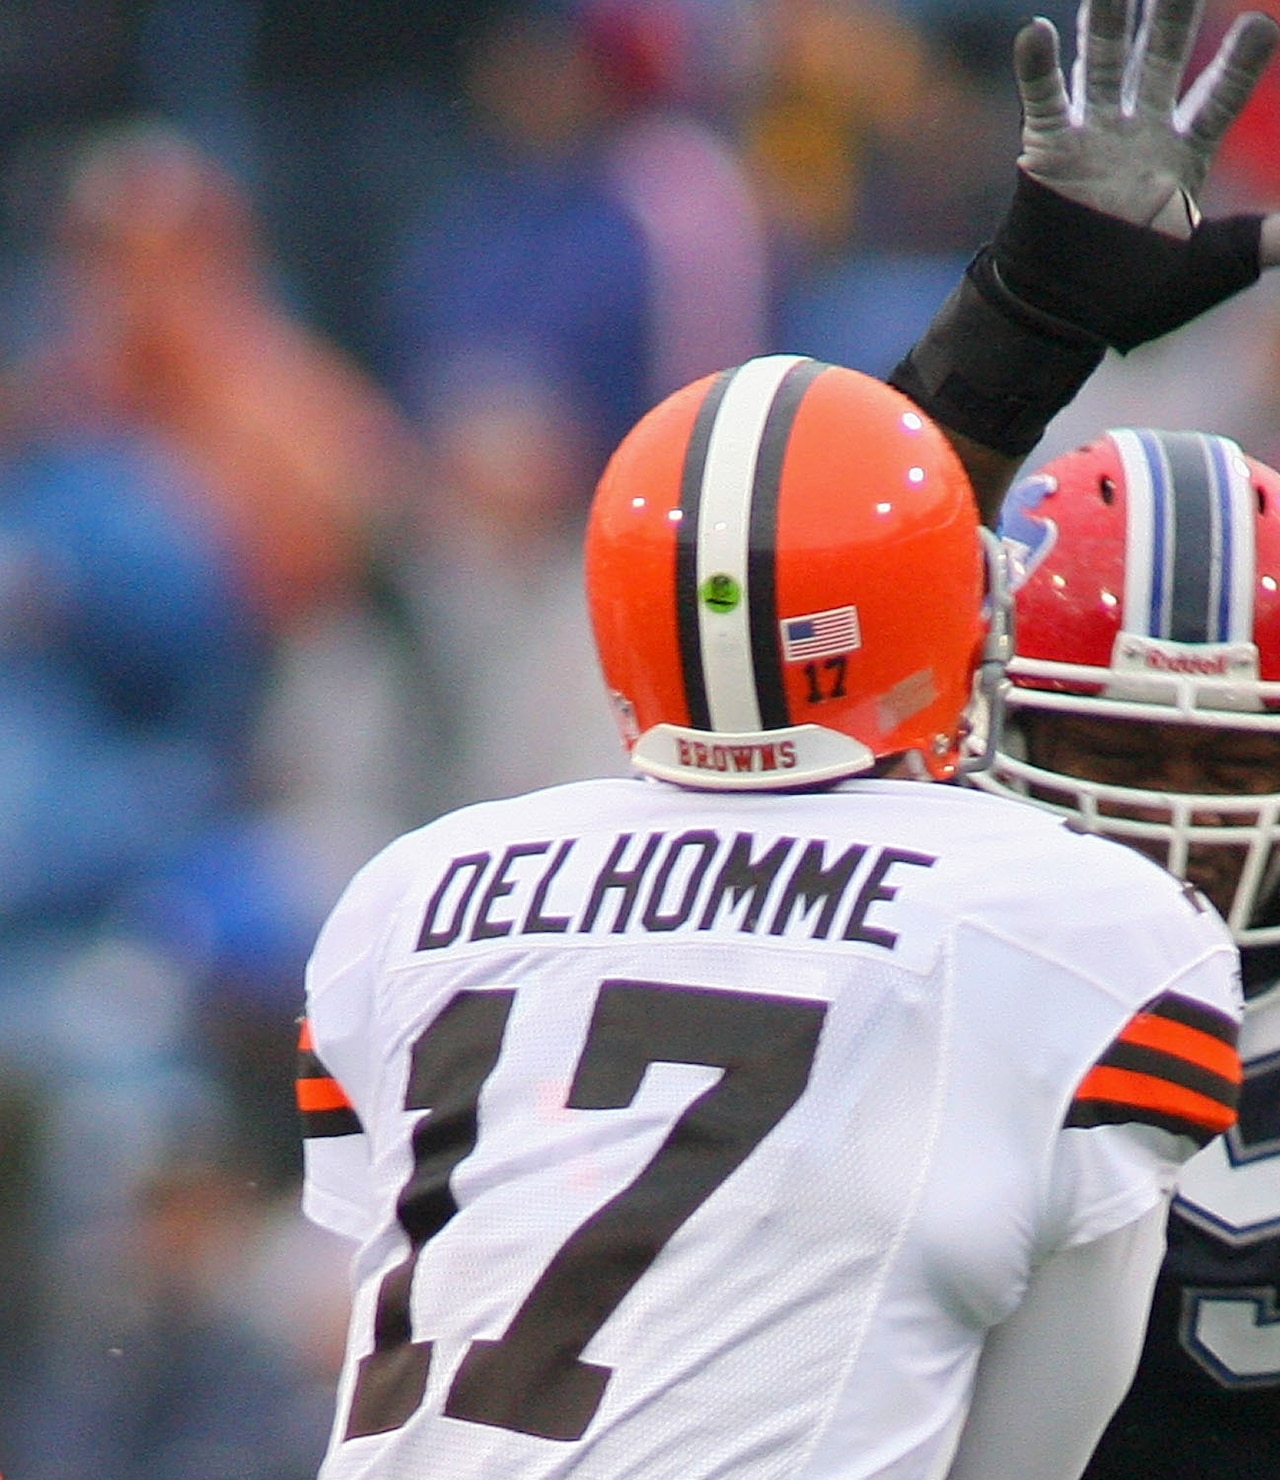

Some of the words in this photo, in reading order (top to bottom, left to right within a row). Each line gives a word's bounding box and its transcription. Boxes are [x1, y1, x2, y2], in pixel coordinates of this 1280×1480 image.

[804, 656, 848, 703] 17
[678, 739, 797, 772] BROWNS
[415, 828, 938, 950] DELHOMME
[343, 978, 829, 1443] 17
